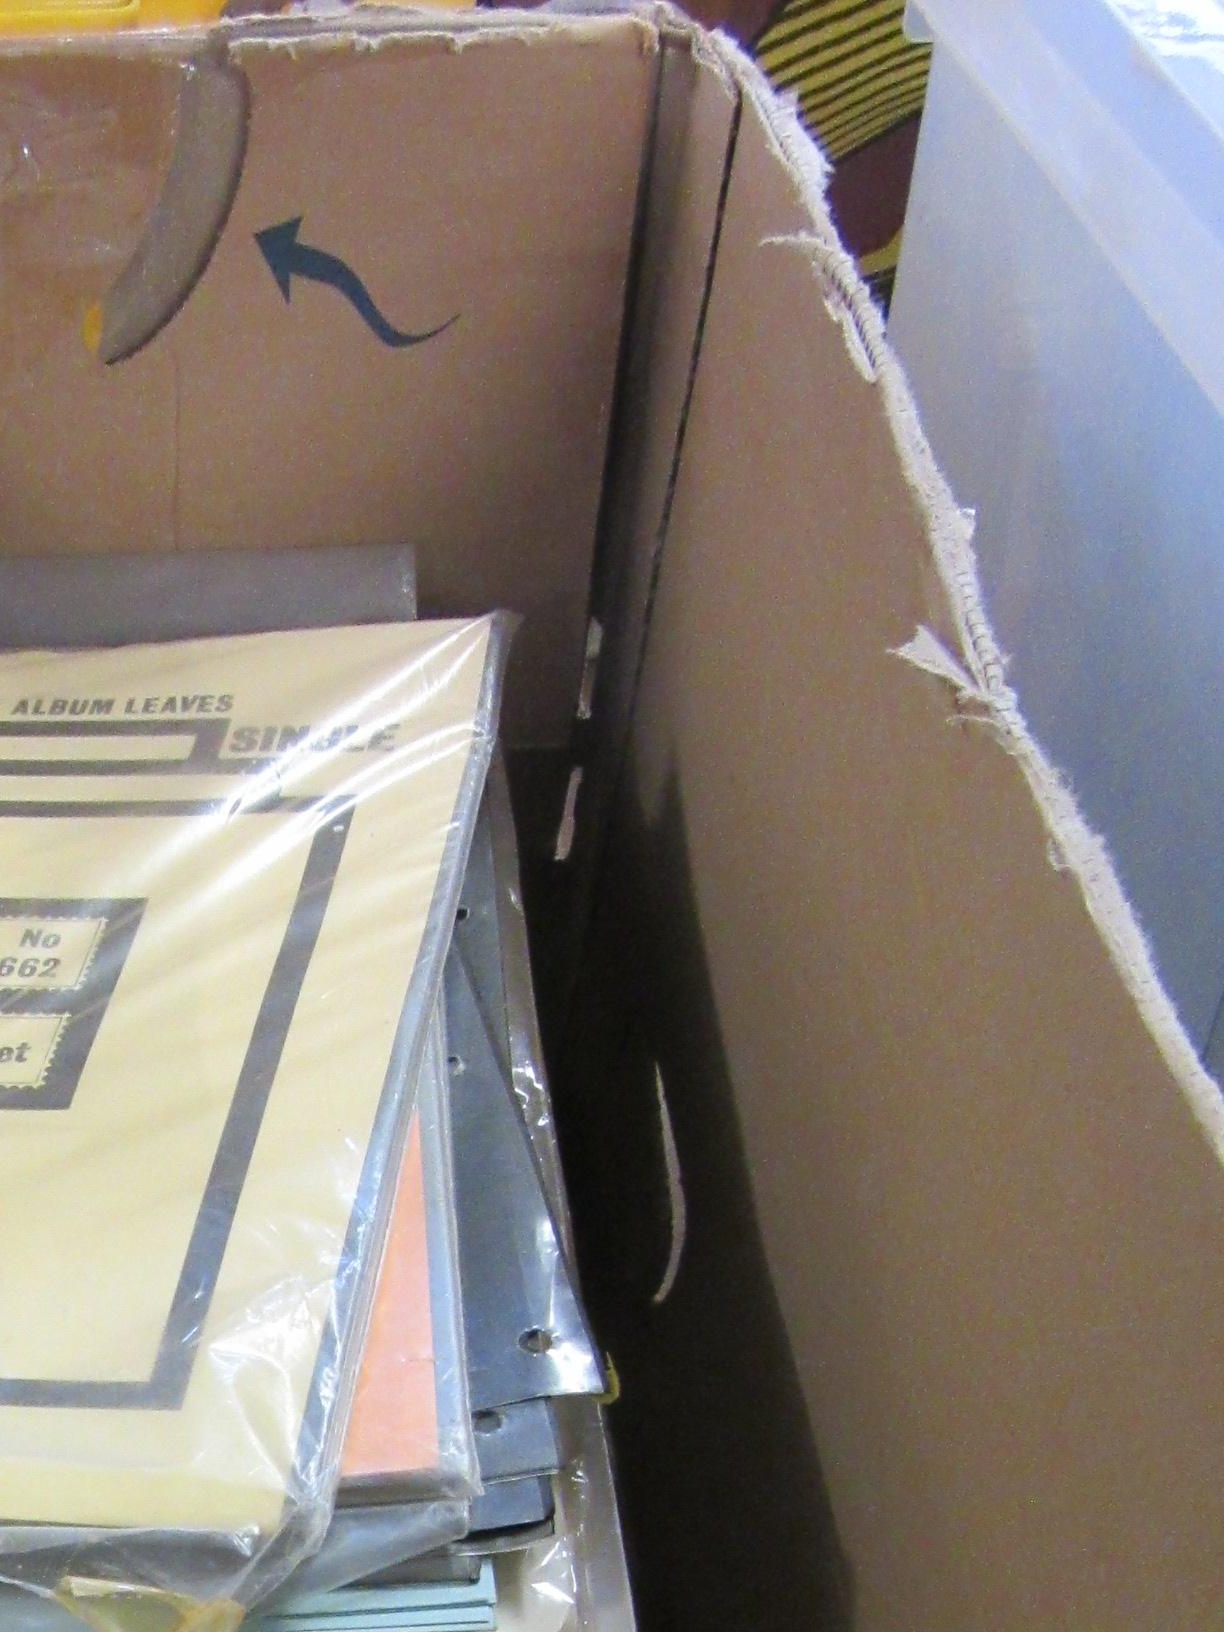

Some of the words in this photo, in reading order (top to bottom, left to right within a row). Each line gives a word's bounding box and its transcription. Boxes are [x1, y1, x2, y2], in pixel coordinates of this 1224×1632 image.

[12, 697, 113, 717] ALBUM
[124, 693, 234, 715] LEAVES
[19, 928, 62, 950] No
